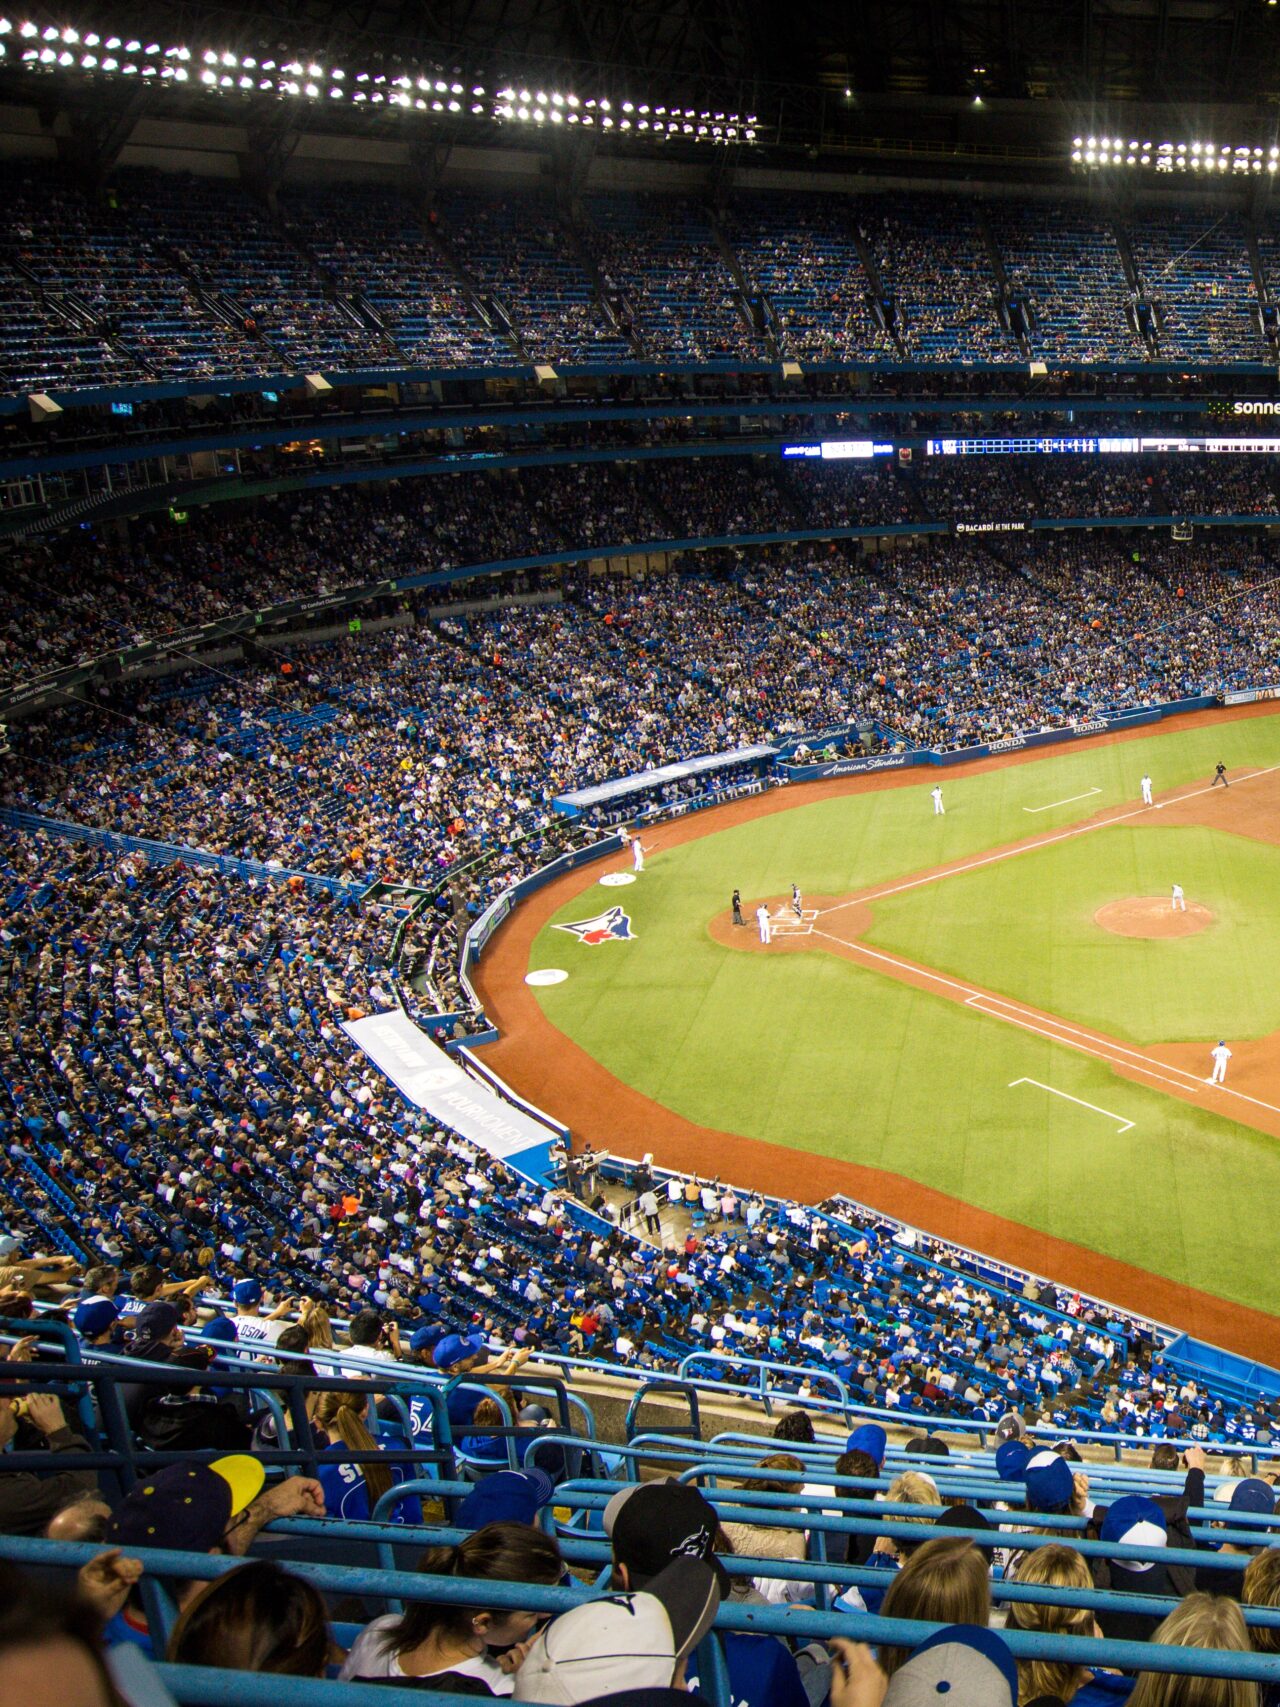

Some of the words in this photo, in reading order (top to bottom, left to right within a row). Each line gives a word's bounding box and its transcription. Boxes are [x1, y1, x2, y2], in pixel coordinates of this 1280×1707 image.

[965, 522, 994, 531] BACARDÍ
[1001, 523, 1010, 531] THE
[1011, 522, 1025, 530] PARK
[307, 600, 325, 609] Comfort
[325, 596, 346, 604] Clubhouse
[16, 690, 34, 701] Comfort
[855, 720, 874, 728] GROHE
[1073, 721, 1108, 733] HONDA
[780, 735, 817, 748] American
[817, 726, 851, 741] Standard
[989, 738, 1026, 751] HONDA
[823, 763, 867, 775] American
[865, 756, 905, 770] Standard
